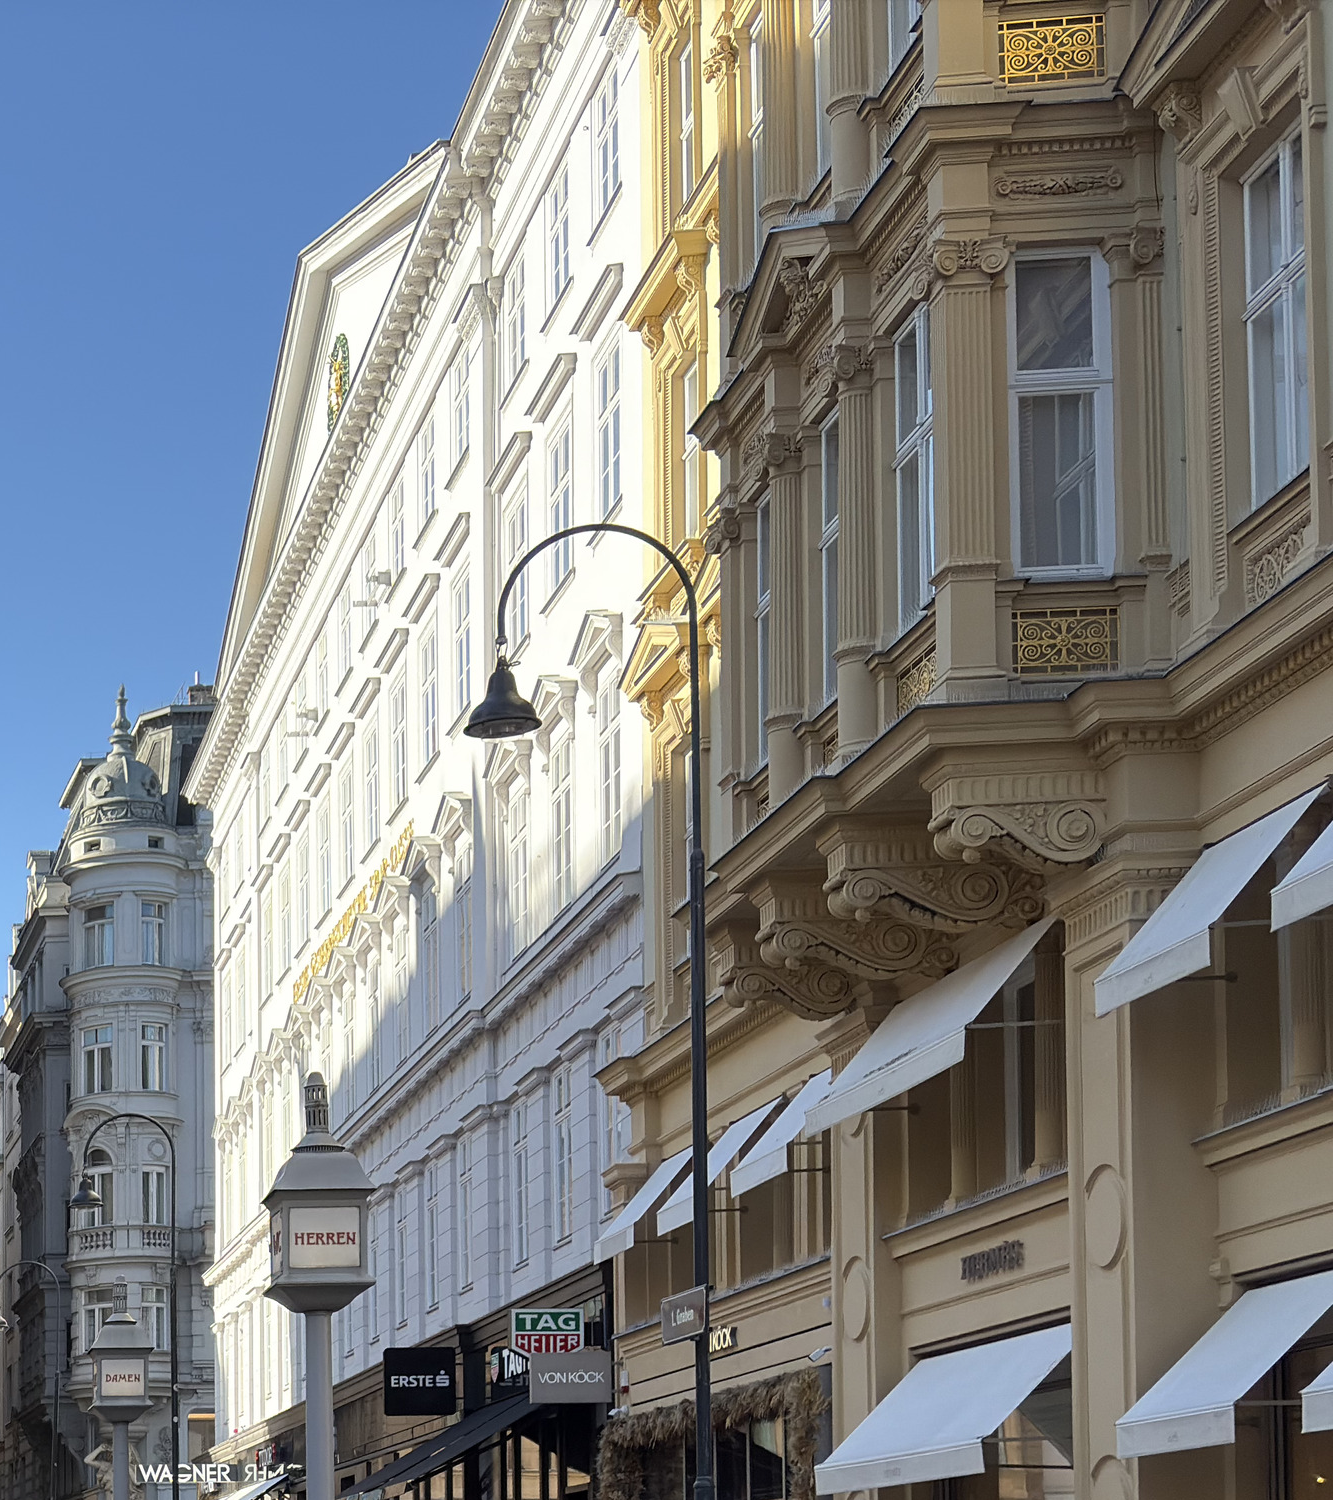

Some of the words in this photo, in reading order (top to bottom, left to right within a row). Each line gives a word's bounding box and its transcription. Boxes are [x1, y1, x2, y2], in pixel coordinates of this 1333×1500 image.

[294, 1231, 357, 1246] HERREN
[518, 1313, 576, 1331] TAG
[105, 1373, 141, 1383] DAMEN
[390, 1375, 434, 1388] ERSTE
[538, 1371, 567, 1385] VON
[568, 1369, 605, 1385] KÖCK
[138, 1463, 231, 1482] WAGNER
